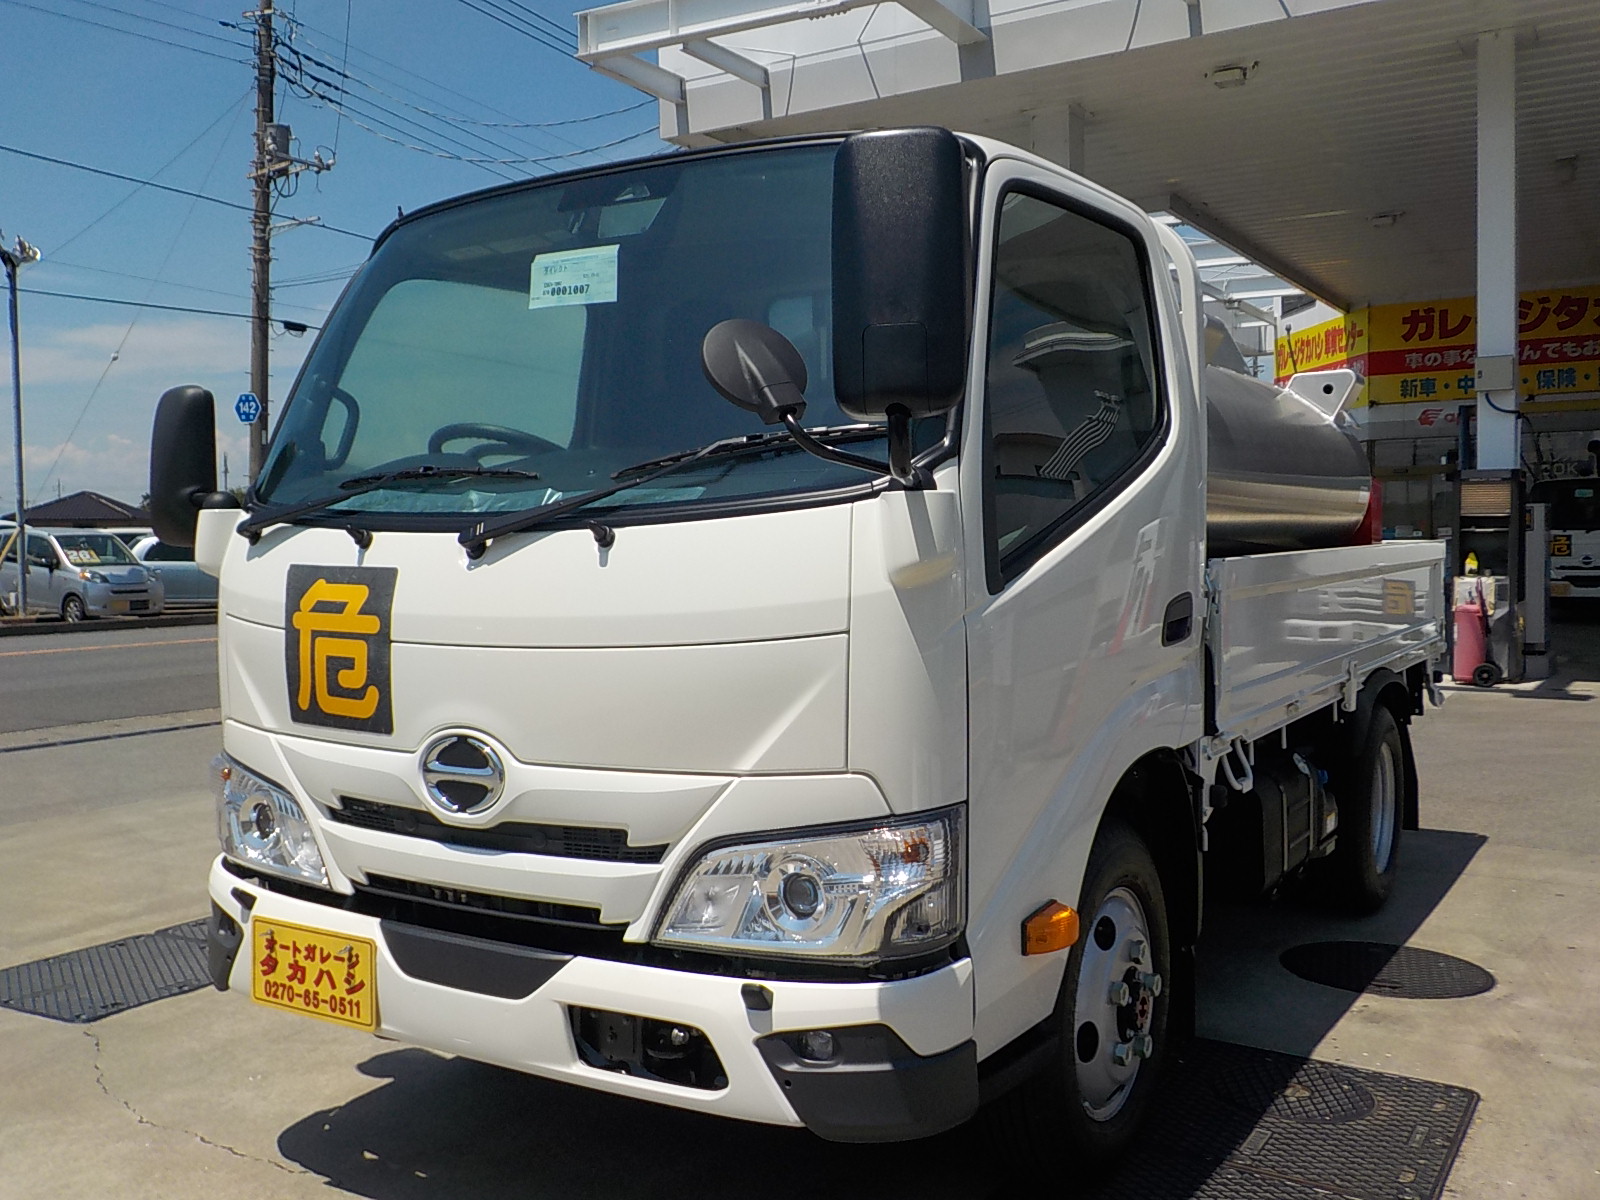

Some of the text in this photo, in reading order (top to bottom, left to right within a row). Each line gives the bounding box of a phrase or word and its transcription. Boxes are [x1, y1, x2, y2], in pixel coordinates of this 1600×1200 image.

[550, 284, 590, 297] 0001007
[238, 401, 256, 414] 142
[293, 579, 381, 719] 危
[264, 937, 360, 970] オートガレージ
[260, 953, 365, 995] タカハシ
[264, 979, 361, 1019] 0270-65-0511
